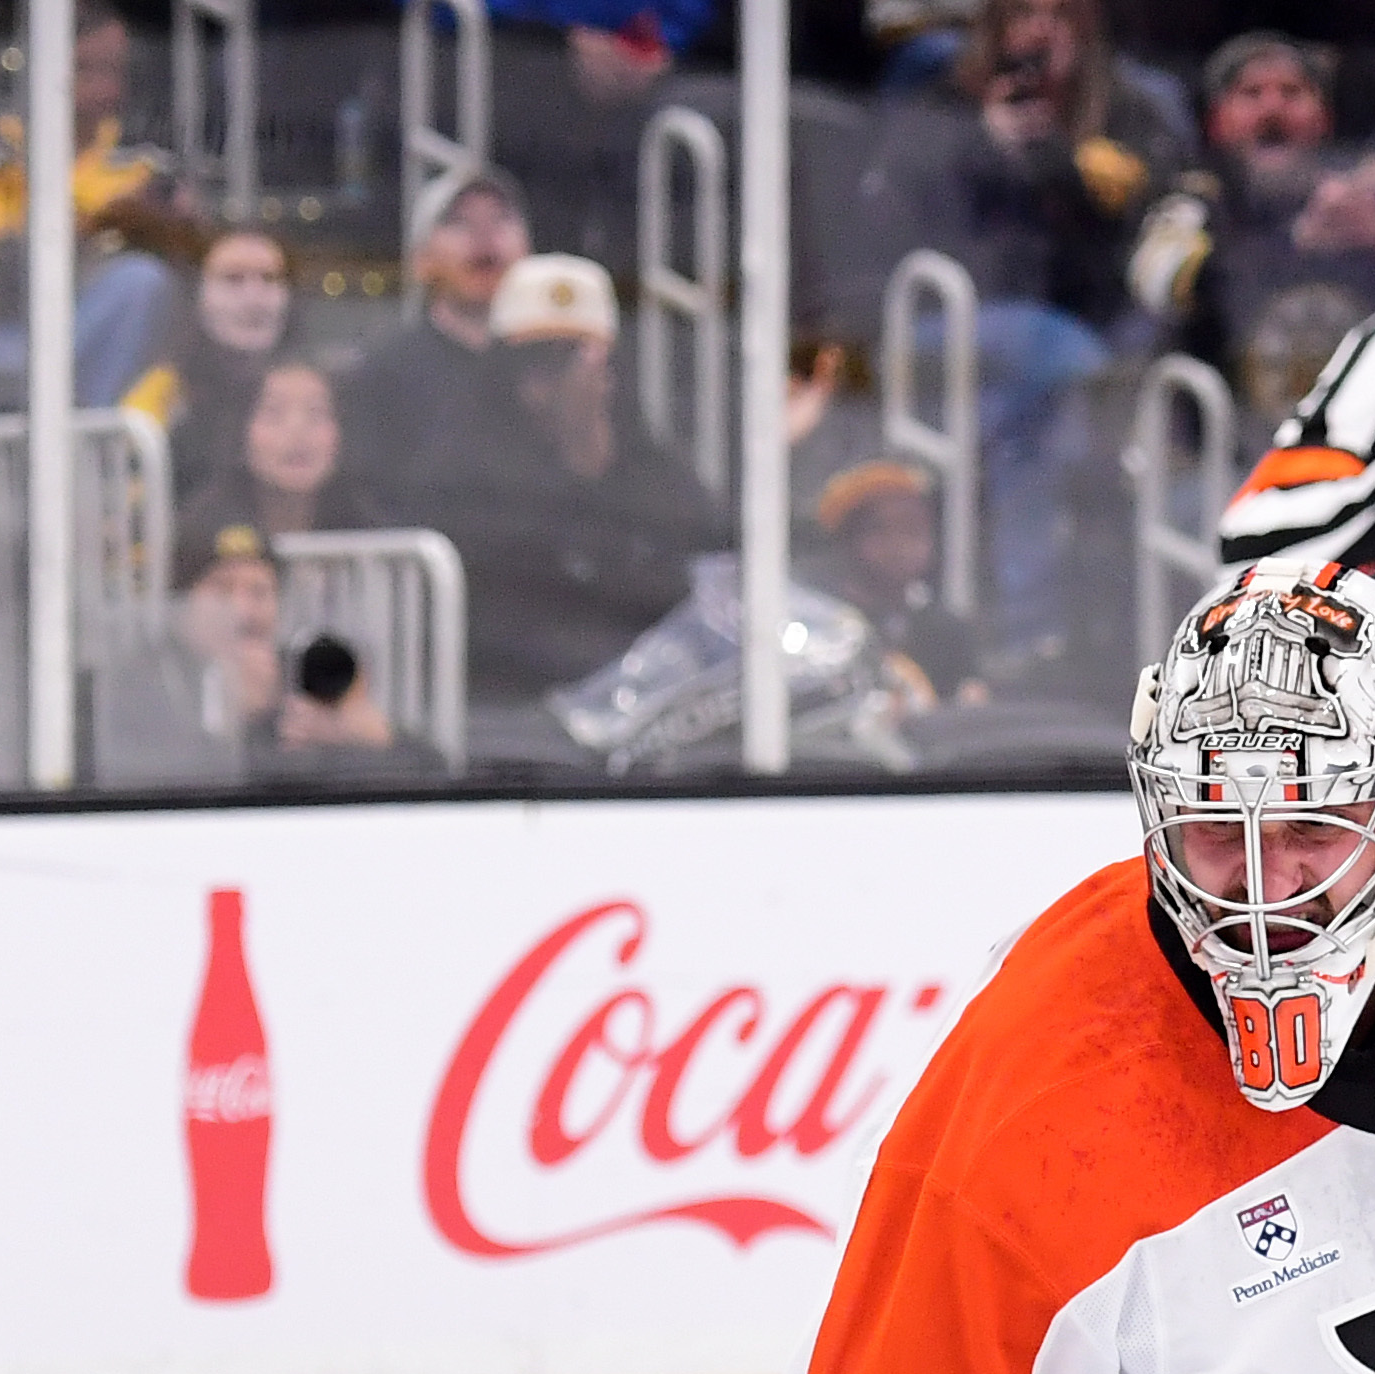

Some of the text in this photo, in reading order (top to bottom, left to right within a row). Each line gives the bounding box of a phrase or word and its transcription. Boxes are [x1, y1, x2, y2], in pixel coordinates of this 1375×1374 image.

[1230, 994, 1322, 1090] 80
[1232, 1249, 1341, 1303] Penn Medicine
